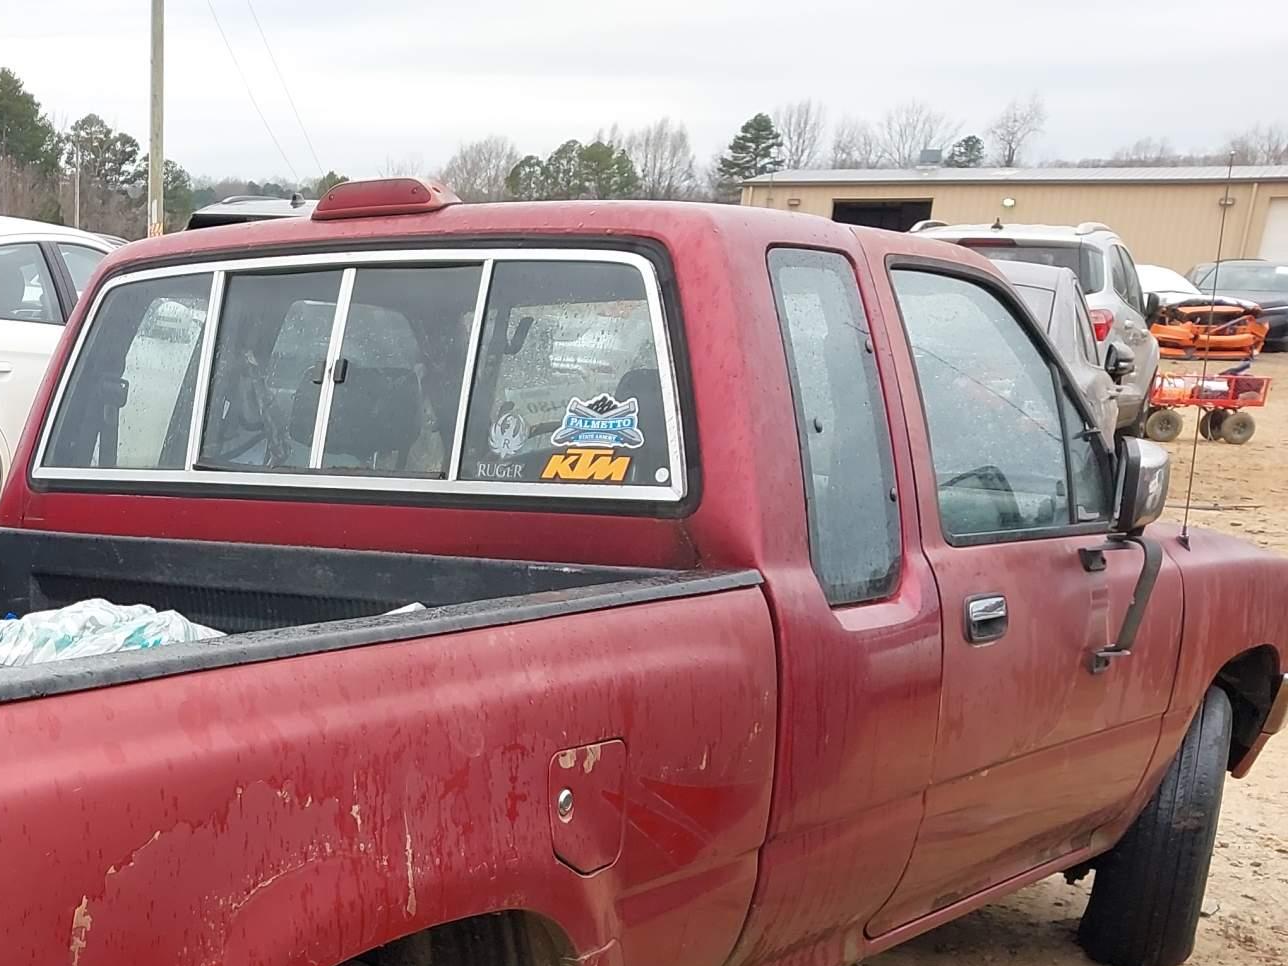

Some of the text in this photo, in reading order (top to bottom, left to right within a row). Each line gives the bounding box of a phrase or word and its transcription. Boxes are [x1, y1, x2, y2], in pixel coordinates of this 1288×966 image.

[569, 417, 632, 429] PALMETTO
[476, 463, 523, 478] RUGER
[541, 448, 631, 481] KTM
